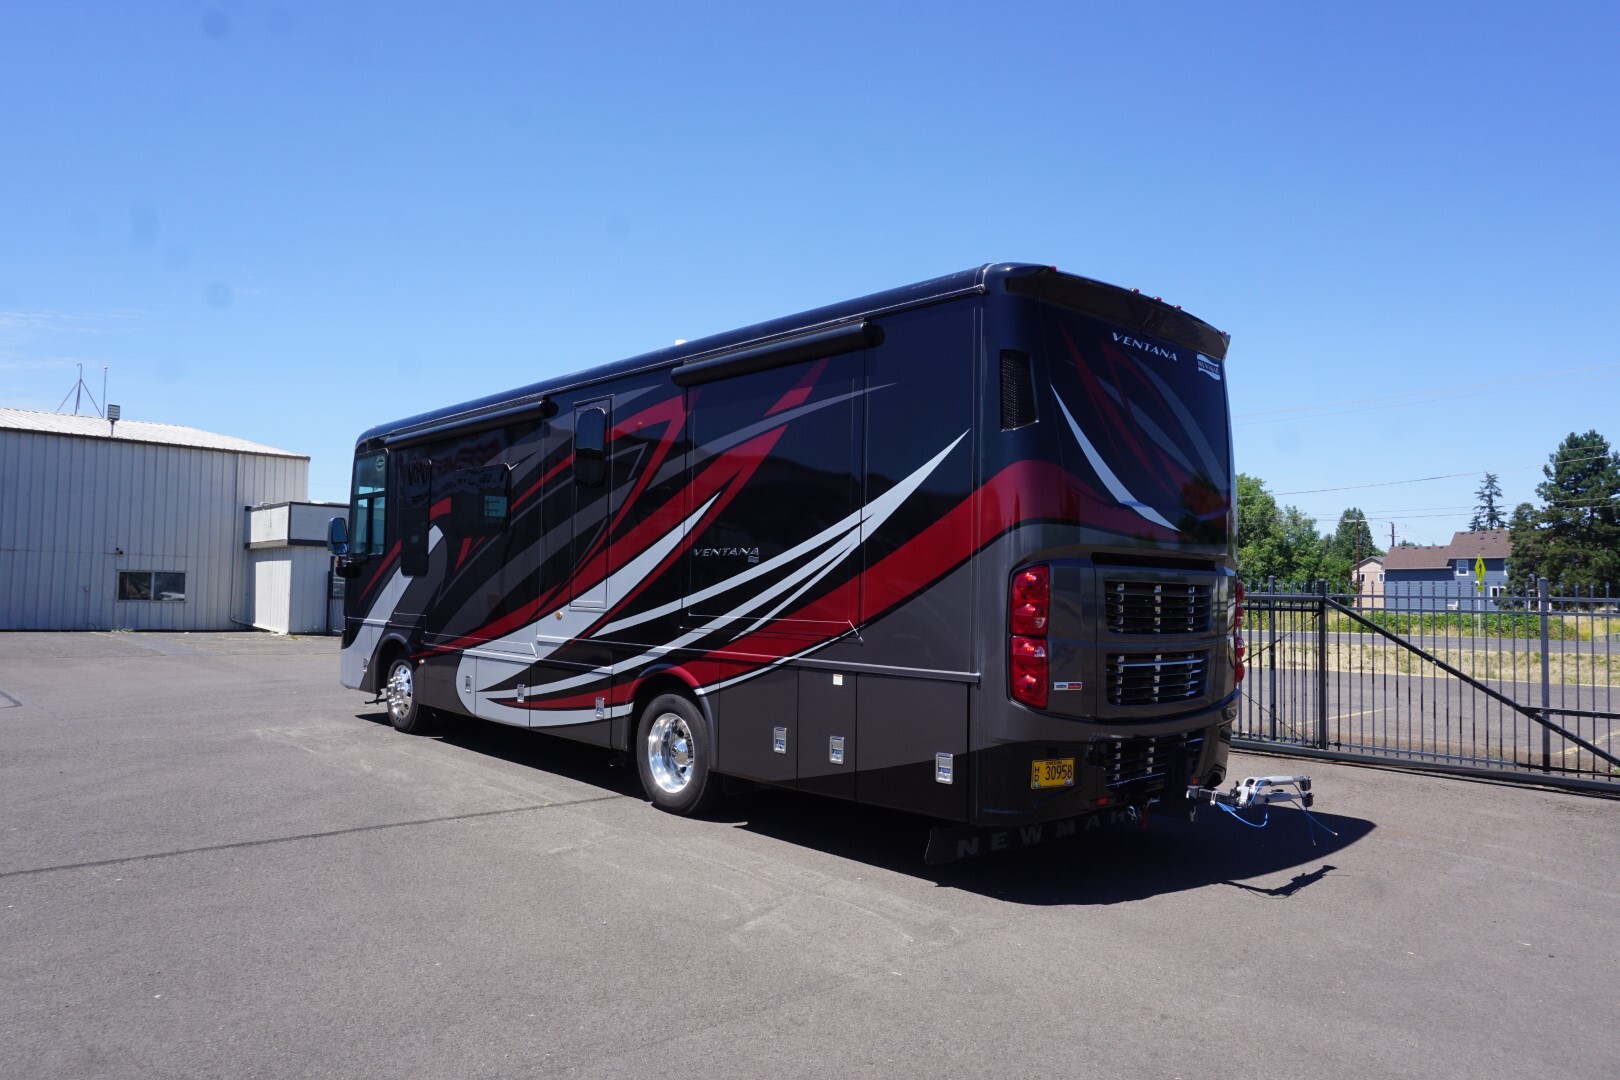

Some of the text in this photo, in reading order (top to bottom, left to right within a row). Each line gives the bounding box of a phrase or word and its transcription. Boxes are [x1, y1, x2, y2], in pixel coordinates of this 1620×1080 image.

[1112, 332, 1178, 362] VENTANA
[693, 547, 760, 557] VENTANA
[1045, 765, 1073, 781] 30958
